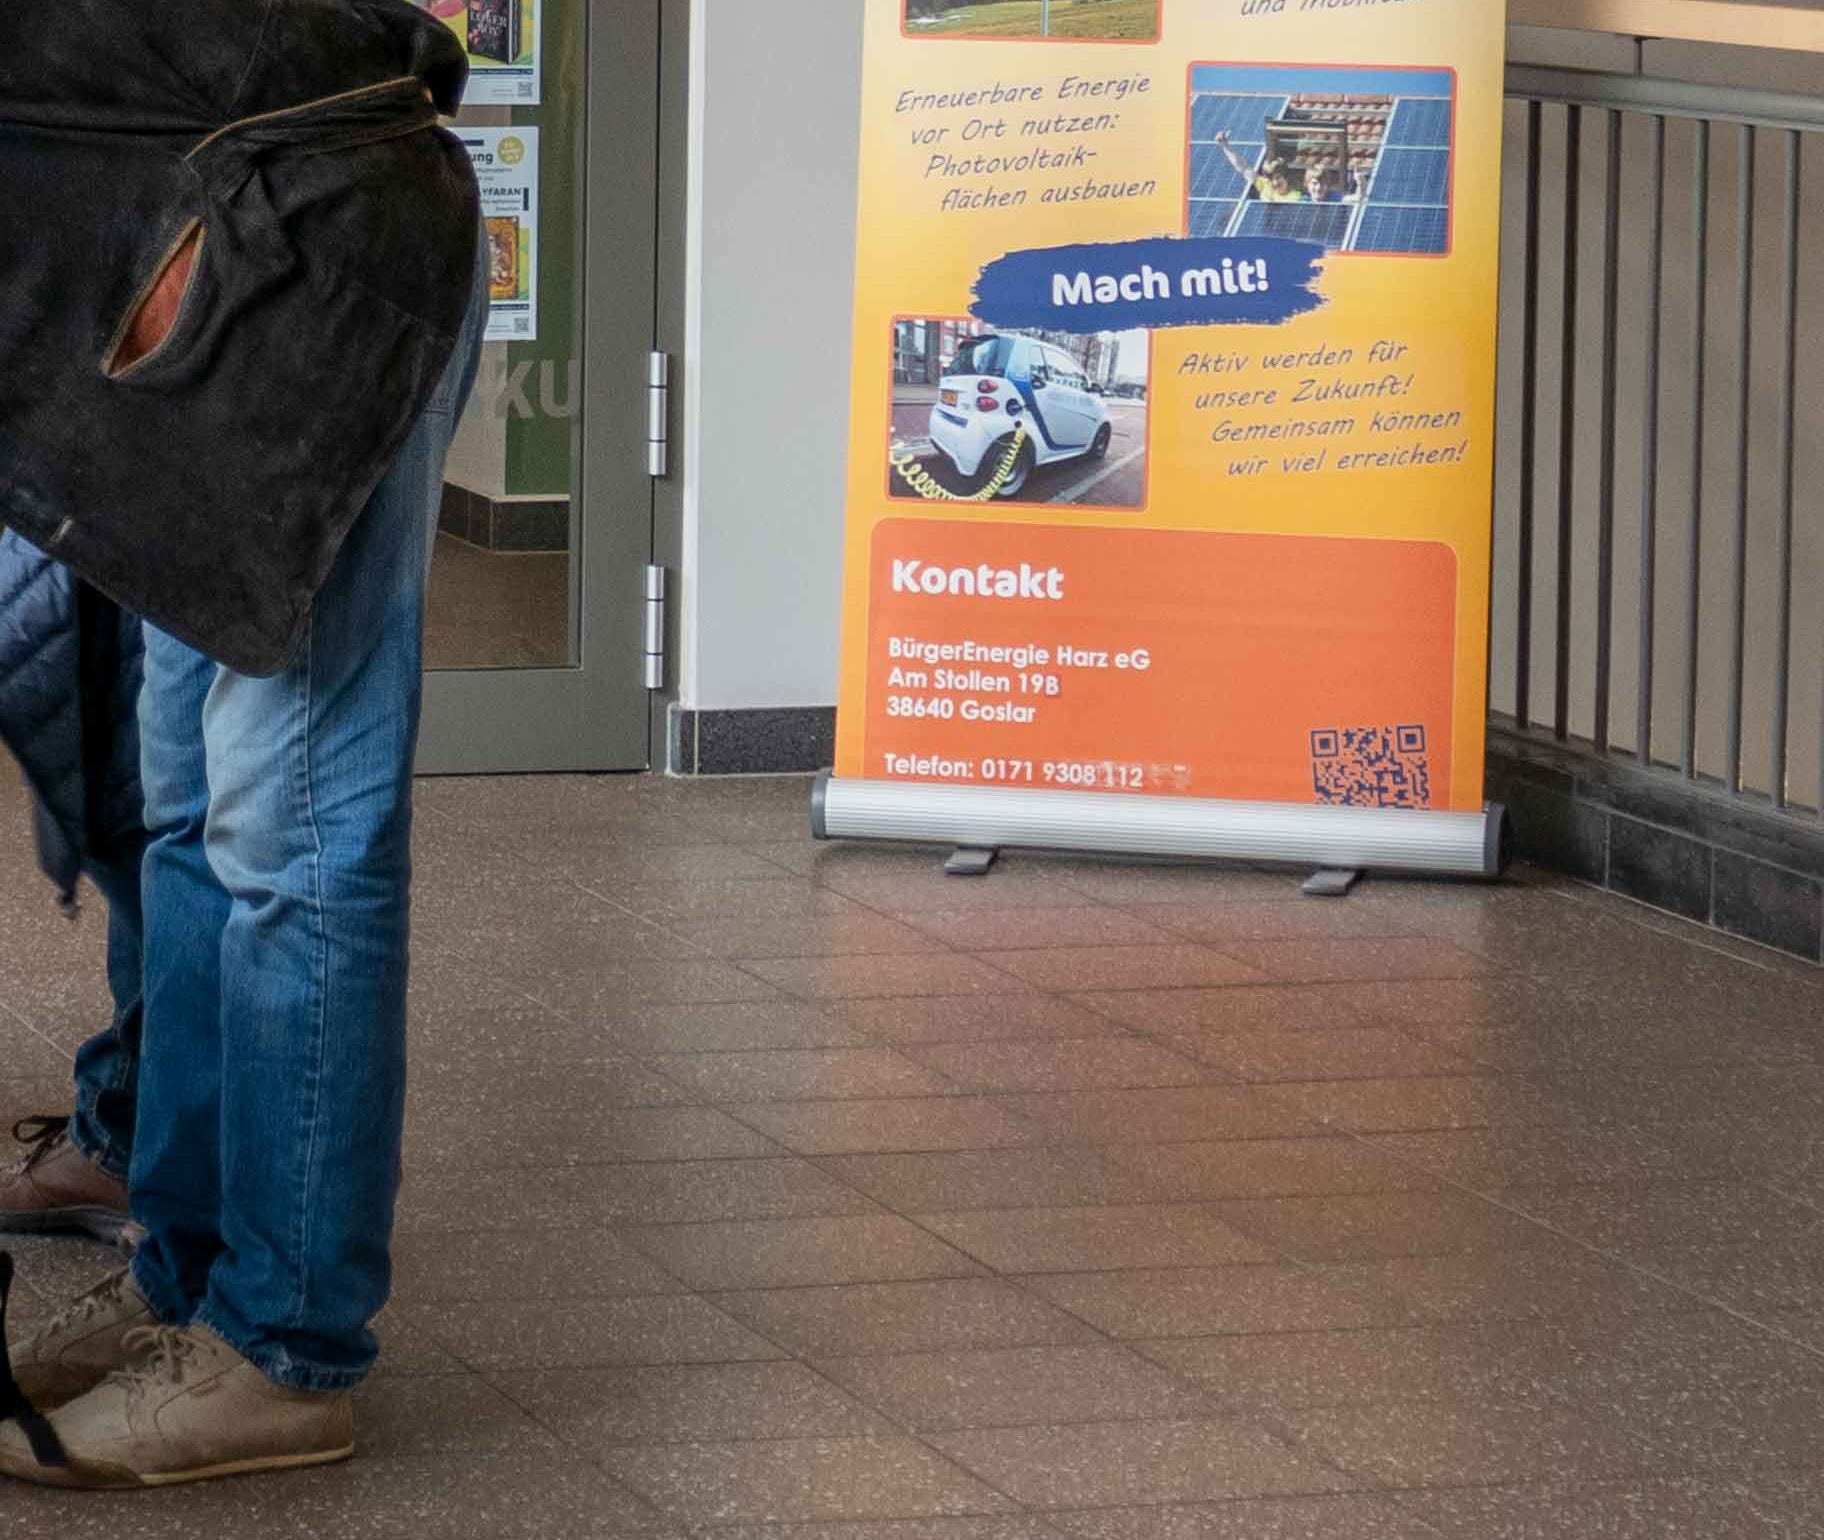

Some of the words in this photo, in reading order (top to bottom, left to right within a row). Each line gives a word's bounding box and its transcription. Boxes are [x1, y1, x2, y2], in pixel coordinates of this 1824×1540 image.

[896, 82, 1043, 112] Erneuerbare
[1058, 74, 1150, 100] Energie
[912, 129, 949, 144] vor
[962, 119, 1007, 140] Ort
[1020, 114, 1120, 135] nutzen:
[926, 145, 1096, 177] Photovoltaik-
[479, 187, 521, 197] YFARAN
[941, 186, 1027, 210] flächen
[1041, 178, 1156, 202] ausbauen
[1053, 265, 1170, 305] Mach
[1181, 258, 1268, 296] mit!
[1178, 353, 1248, 374] Aktiv
[1263, 344, 1352, 369] werden
[1368, 340, 1408, 363] für
[1195, 390, 1277, 409] unsere
[1291, 374, 1414, 402] Zukunft!
[1212, 419, 1354, 442] Gemeinsam
[1370, 412, 1463, 431] können
[1228, 456, 1268, 475] wir
[1283, 449, 1326, 472] viel
[1338, 439, 1468, 469] erreichen!
[892, 559, 1064, 599] Kontakt
[888, 637, 1050, 668] BürgerEnergie
[1057, 646, 1108, 667] Harz
[1114, 648, 1150, 669] eG
[888, 667, 927, 687] Am
[934, 669, 1010, 692] Stollen
[887, 695, 954, 718] 38640
[960, 700, 1036, 722] Goslar
[884, 753, 973, 777] Telefon:
[982, 759, 1032, 780] 0171
